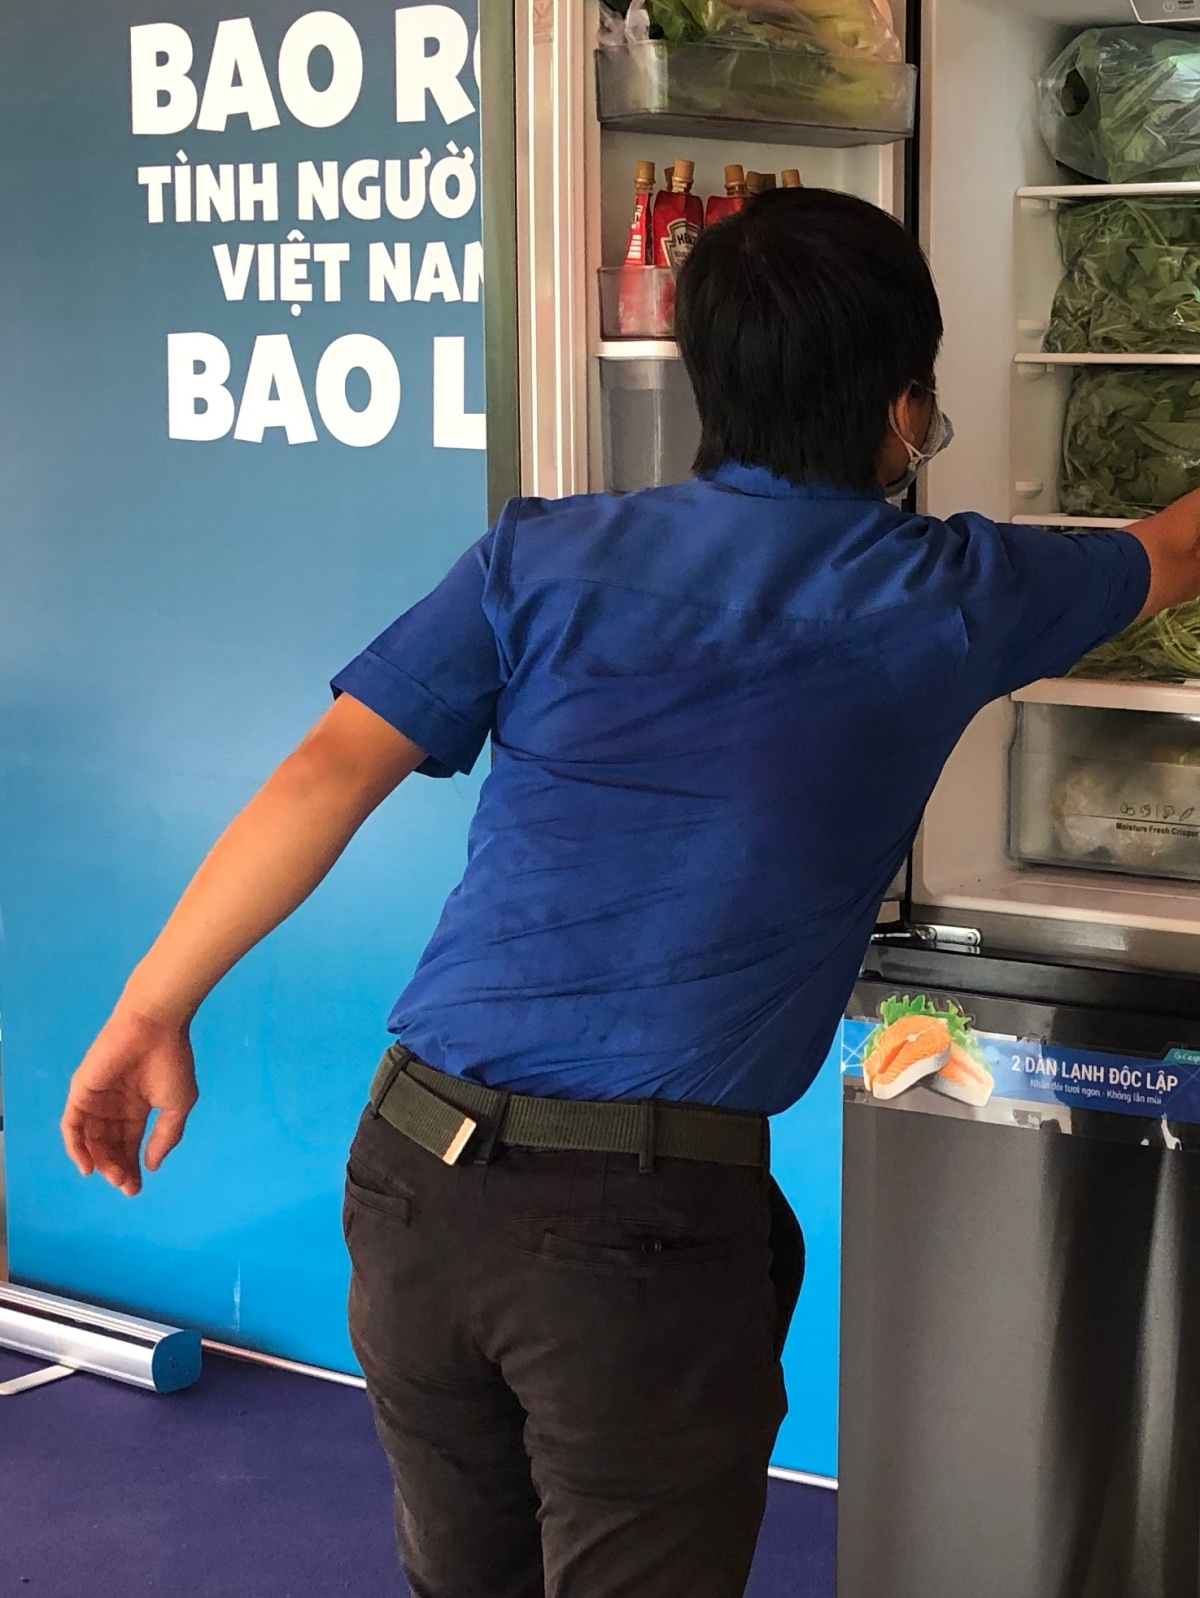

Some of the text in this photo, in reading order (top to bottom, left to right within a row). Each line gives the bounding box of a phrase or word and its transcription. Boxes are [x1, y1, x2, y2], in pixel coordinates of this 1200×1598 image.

[130, 4, 480, 135] BAO R
[138, 140, 476, 223] TÌNH NGƯỜ
[212, 229, 350, 317] VIỆT
[167, 332, 487, 450] BAO L
[1116, 822, 1200, 838] Moisture Fresh Crisper
[1011, 1053, 1179, 1094] 2 DÀN LẠNH ĐỘC LẬP
[1081, 1087, 1101, 1098] ngon
